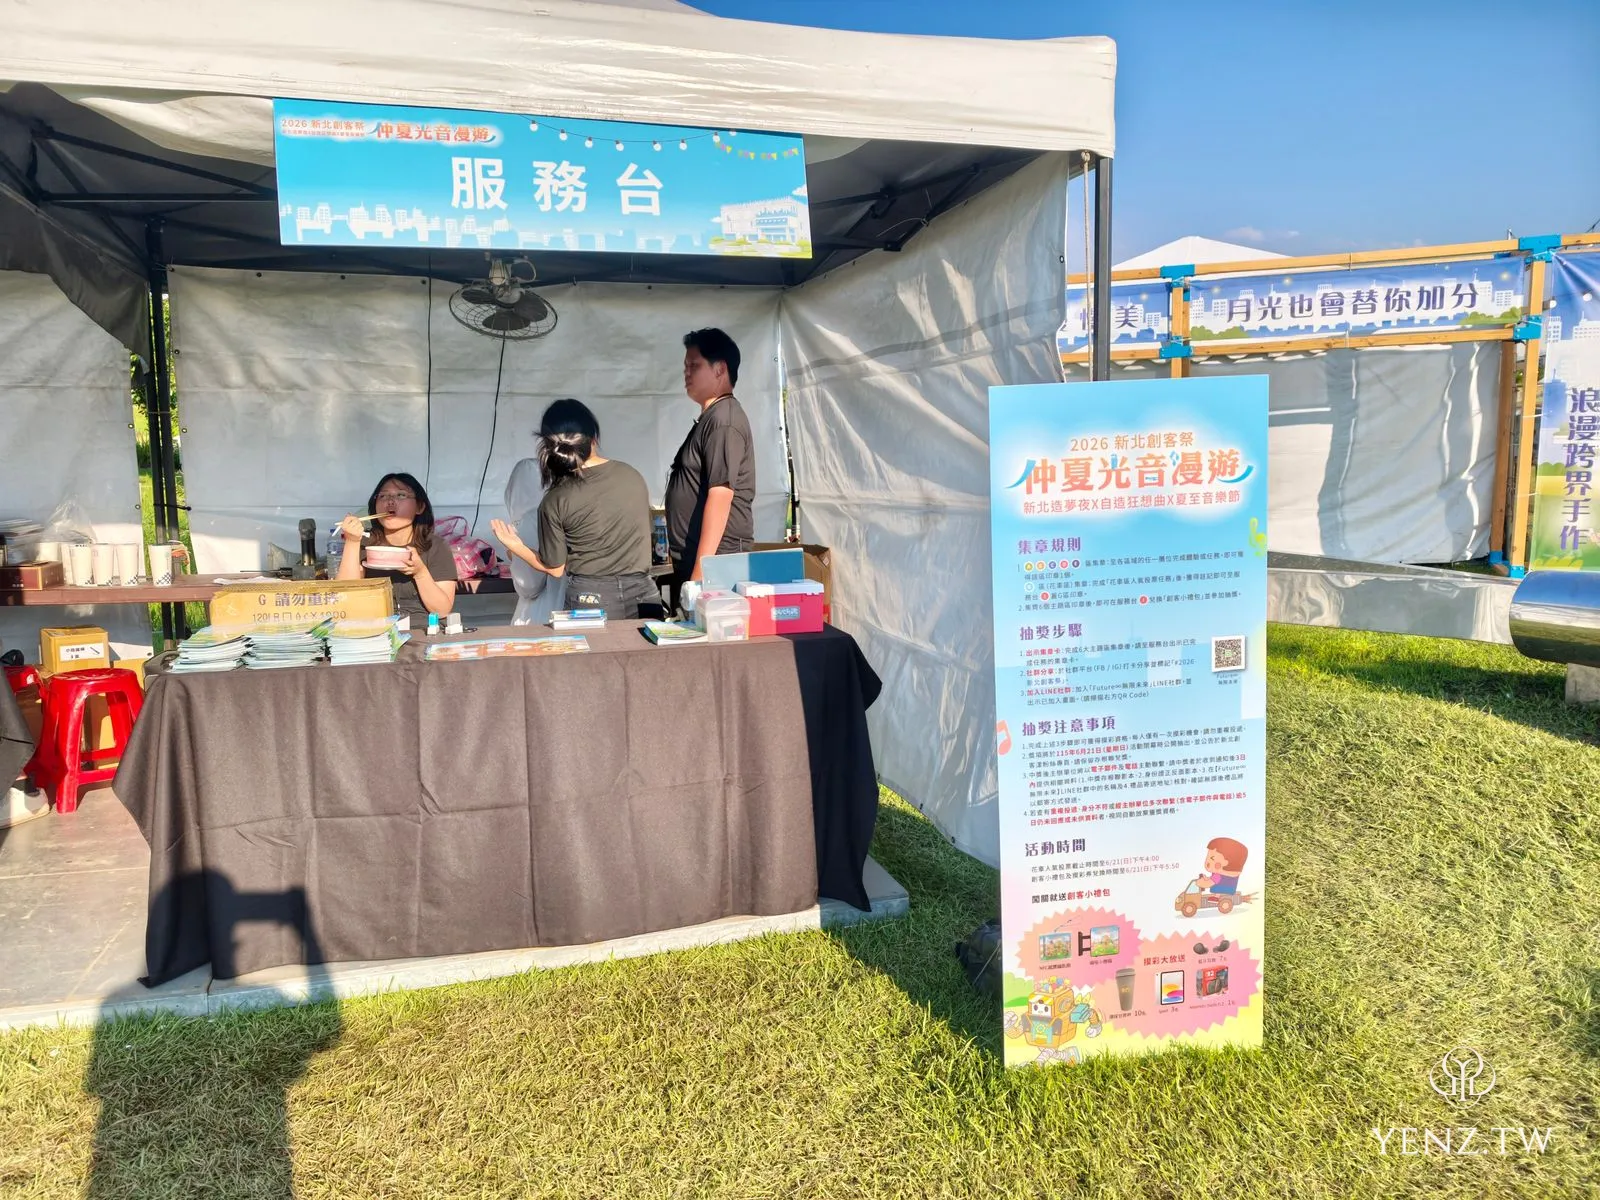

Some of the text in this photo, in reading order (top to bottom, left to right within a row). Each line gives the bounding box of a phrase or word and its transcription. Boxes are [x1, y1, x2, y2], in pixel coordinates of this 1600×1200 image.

[282, 119, 308, 128] 2026
[371, 121, 495, 143] 仲夏光音漫遊
[451, 156, 664, 216] 服務台
[1227, 282, 1479, 323] 月光也會替你加分
[1070, 432, 1194, 451] 2026 新北創客祭
[1015, 449, 1250, 495] 仲夏光音漫遊
[1560, 387, 1600, 550] 浪漫跨界手作
[1018, 537, 1080, 555] 集章規則
[258, 594, 266, 605] G
[1025, 838, 1086, 857] 活動時間
